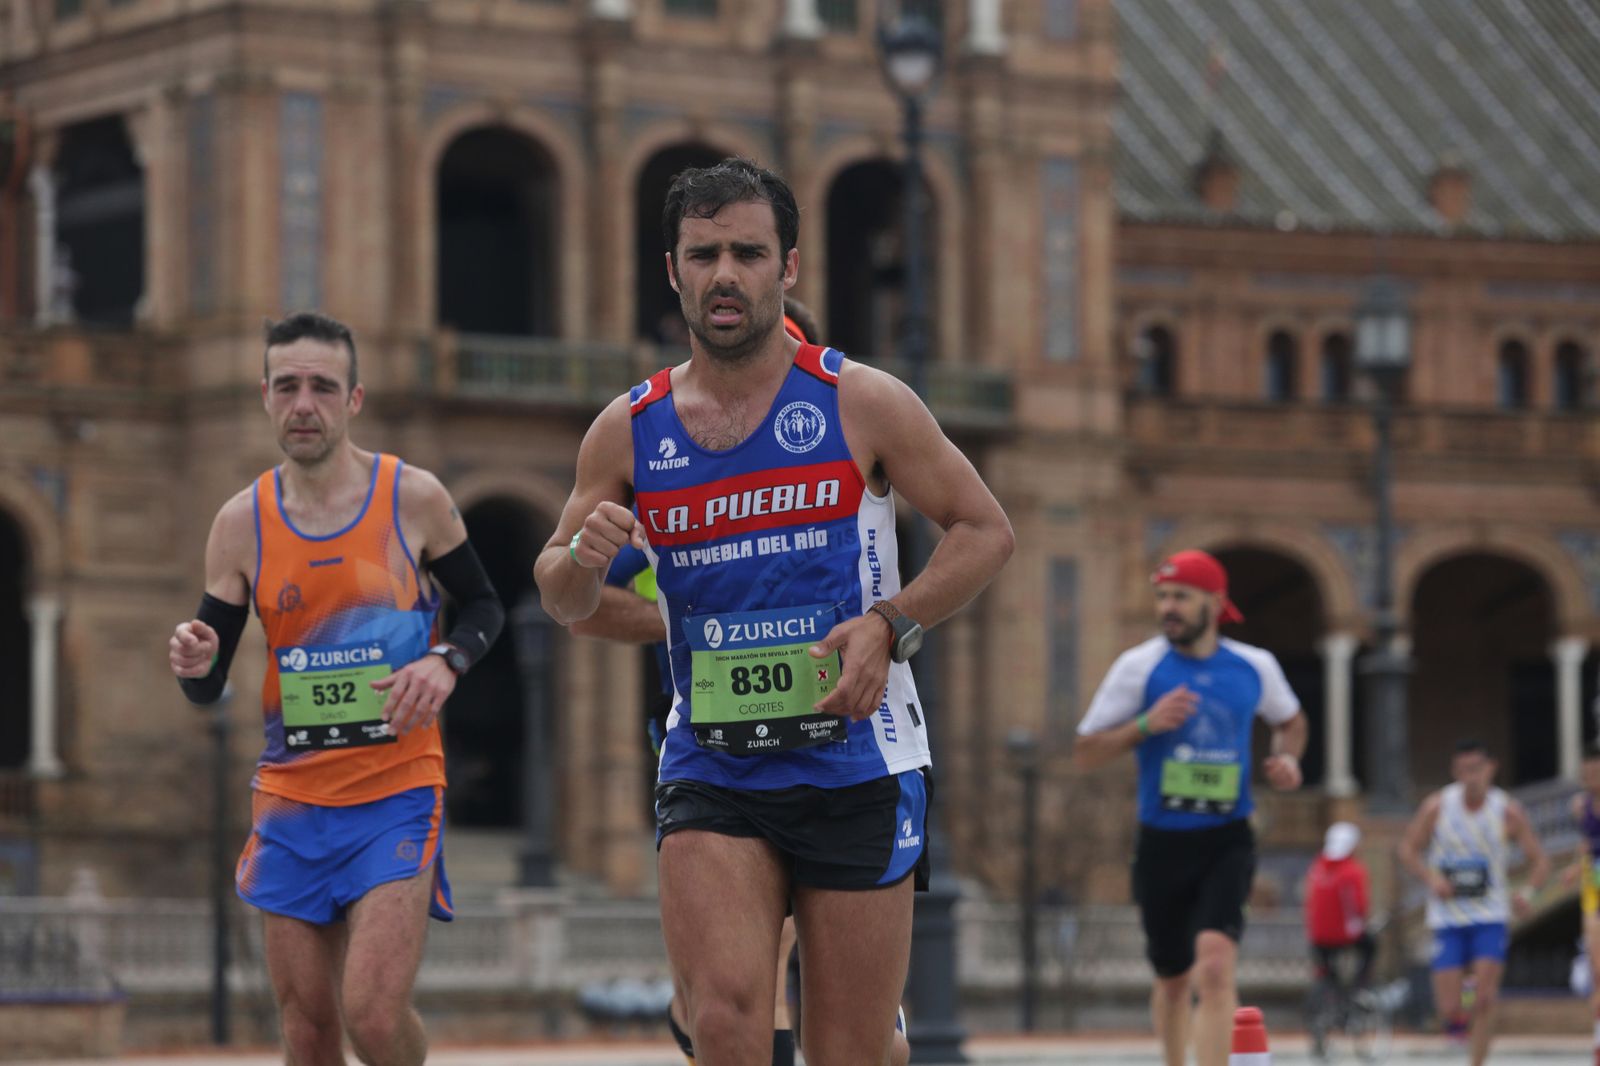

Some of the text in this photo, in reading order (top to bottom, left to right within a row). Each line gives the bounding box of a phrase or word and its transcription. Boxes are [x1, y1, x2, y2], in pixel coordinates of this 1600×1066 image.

[648, 456, 690, 471] VIATOR
[704, 479, 841, 527] PUEBLA
[671, 527, 828, 568] LA PUEBLA DEL RÍO
[867, 528, 882, 598] PUEBLA
[728, 617, 816, 643] ZURICH
[309, 648, 376, 667] ZURICH
[730, 653, 759, 661] MARATÓN
[731, 663, 793, 696] 830
[312, 682, 357, 706] 532
[738, 701, 785, 716] CORTES
[800, 720, 839, 731] Cruzcampo
[746, 738, 780, 749] ZURICH
[898, 835, 920, 849] VIATOR
